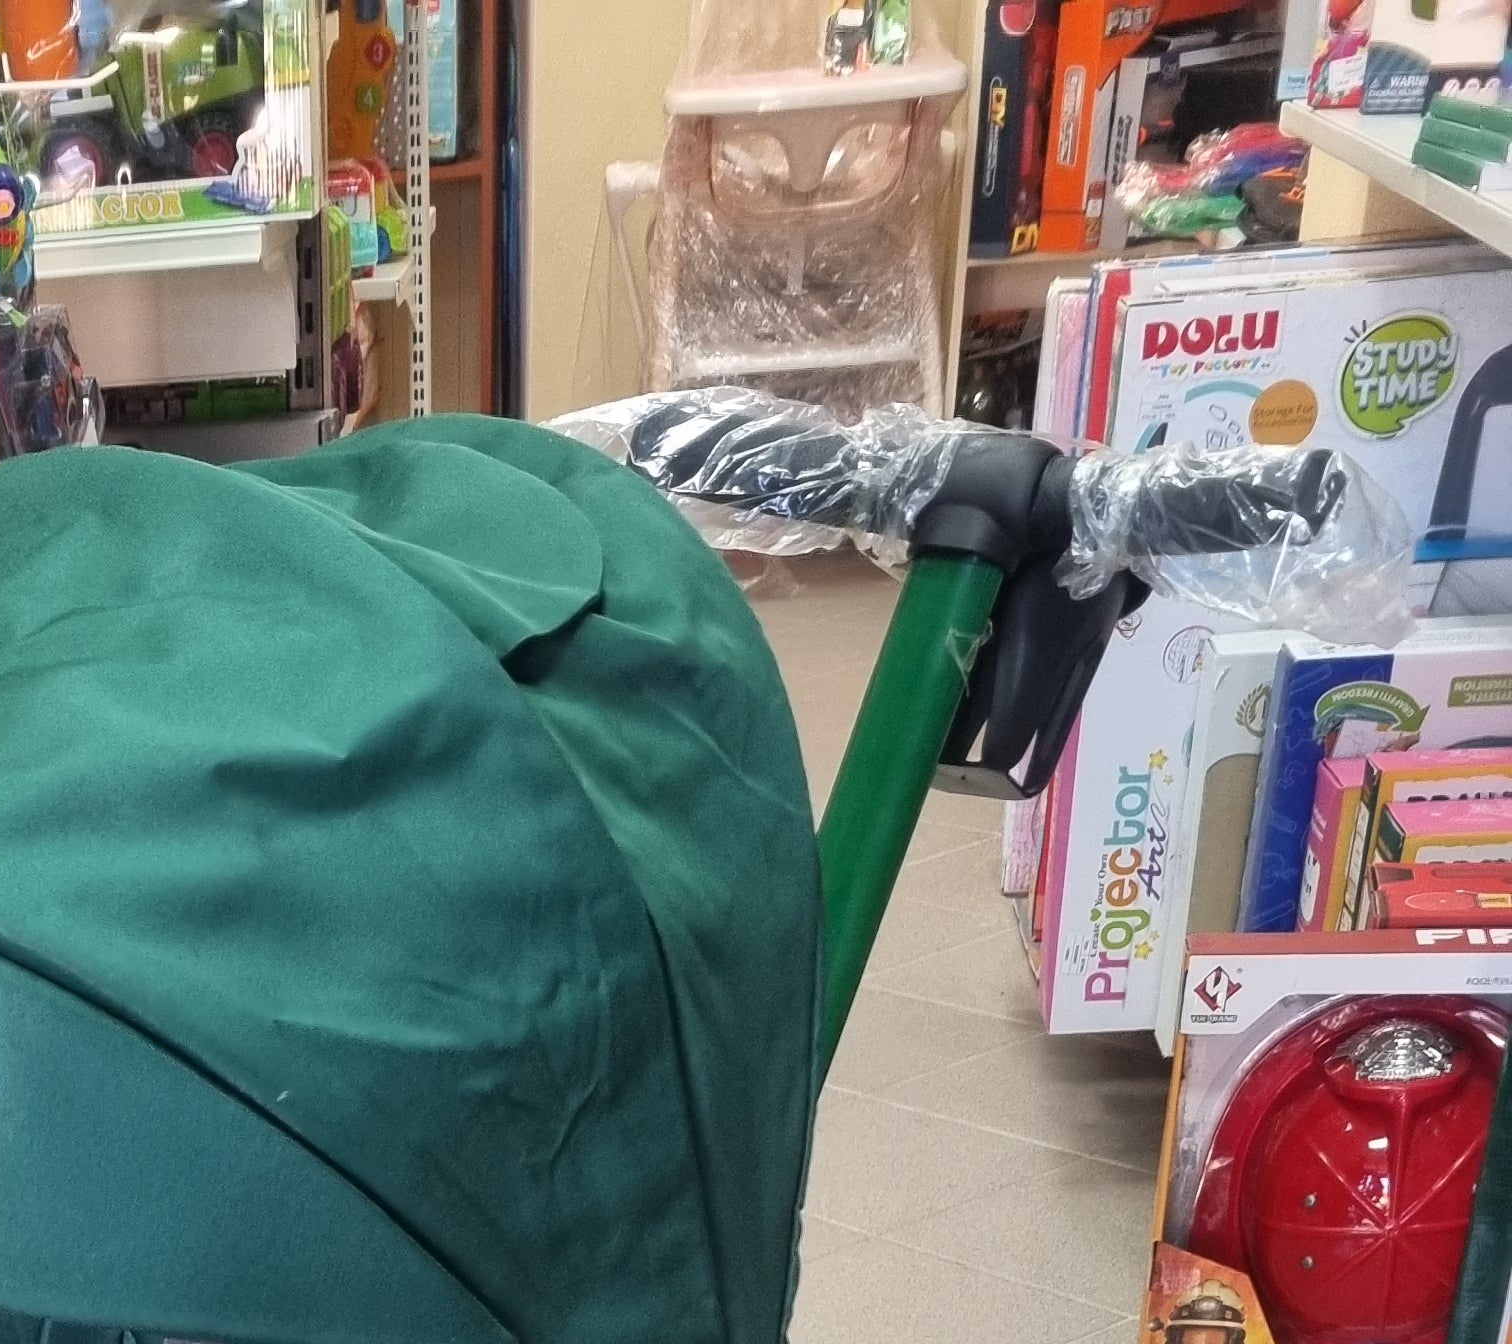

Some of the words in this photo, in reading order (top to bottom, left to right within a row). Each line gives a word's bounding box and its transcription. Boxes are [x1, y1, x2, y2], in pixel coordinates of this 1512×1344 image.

[1141, 310, 1280, 361] DOLU
[1352, 334, 1459, 378] STUDY
[1353, 369, 1440, 410] TIME
[1137, 803, 1168, 902] Art
[1084, 765, 1152, 1003] Projector
[1094, 881, 1106, 907] Your
